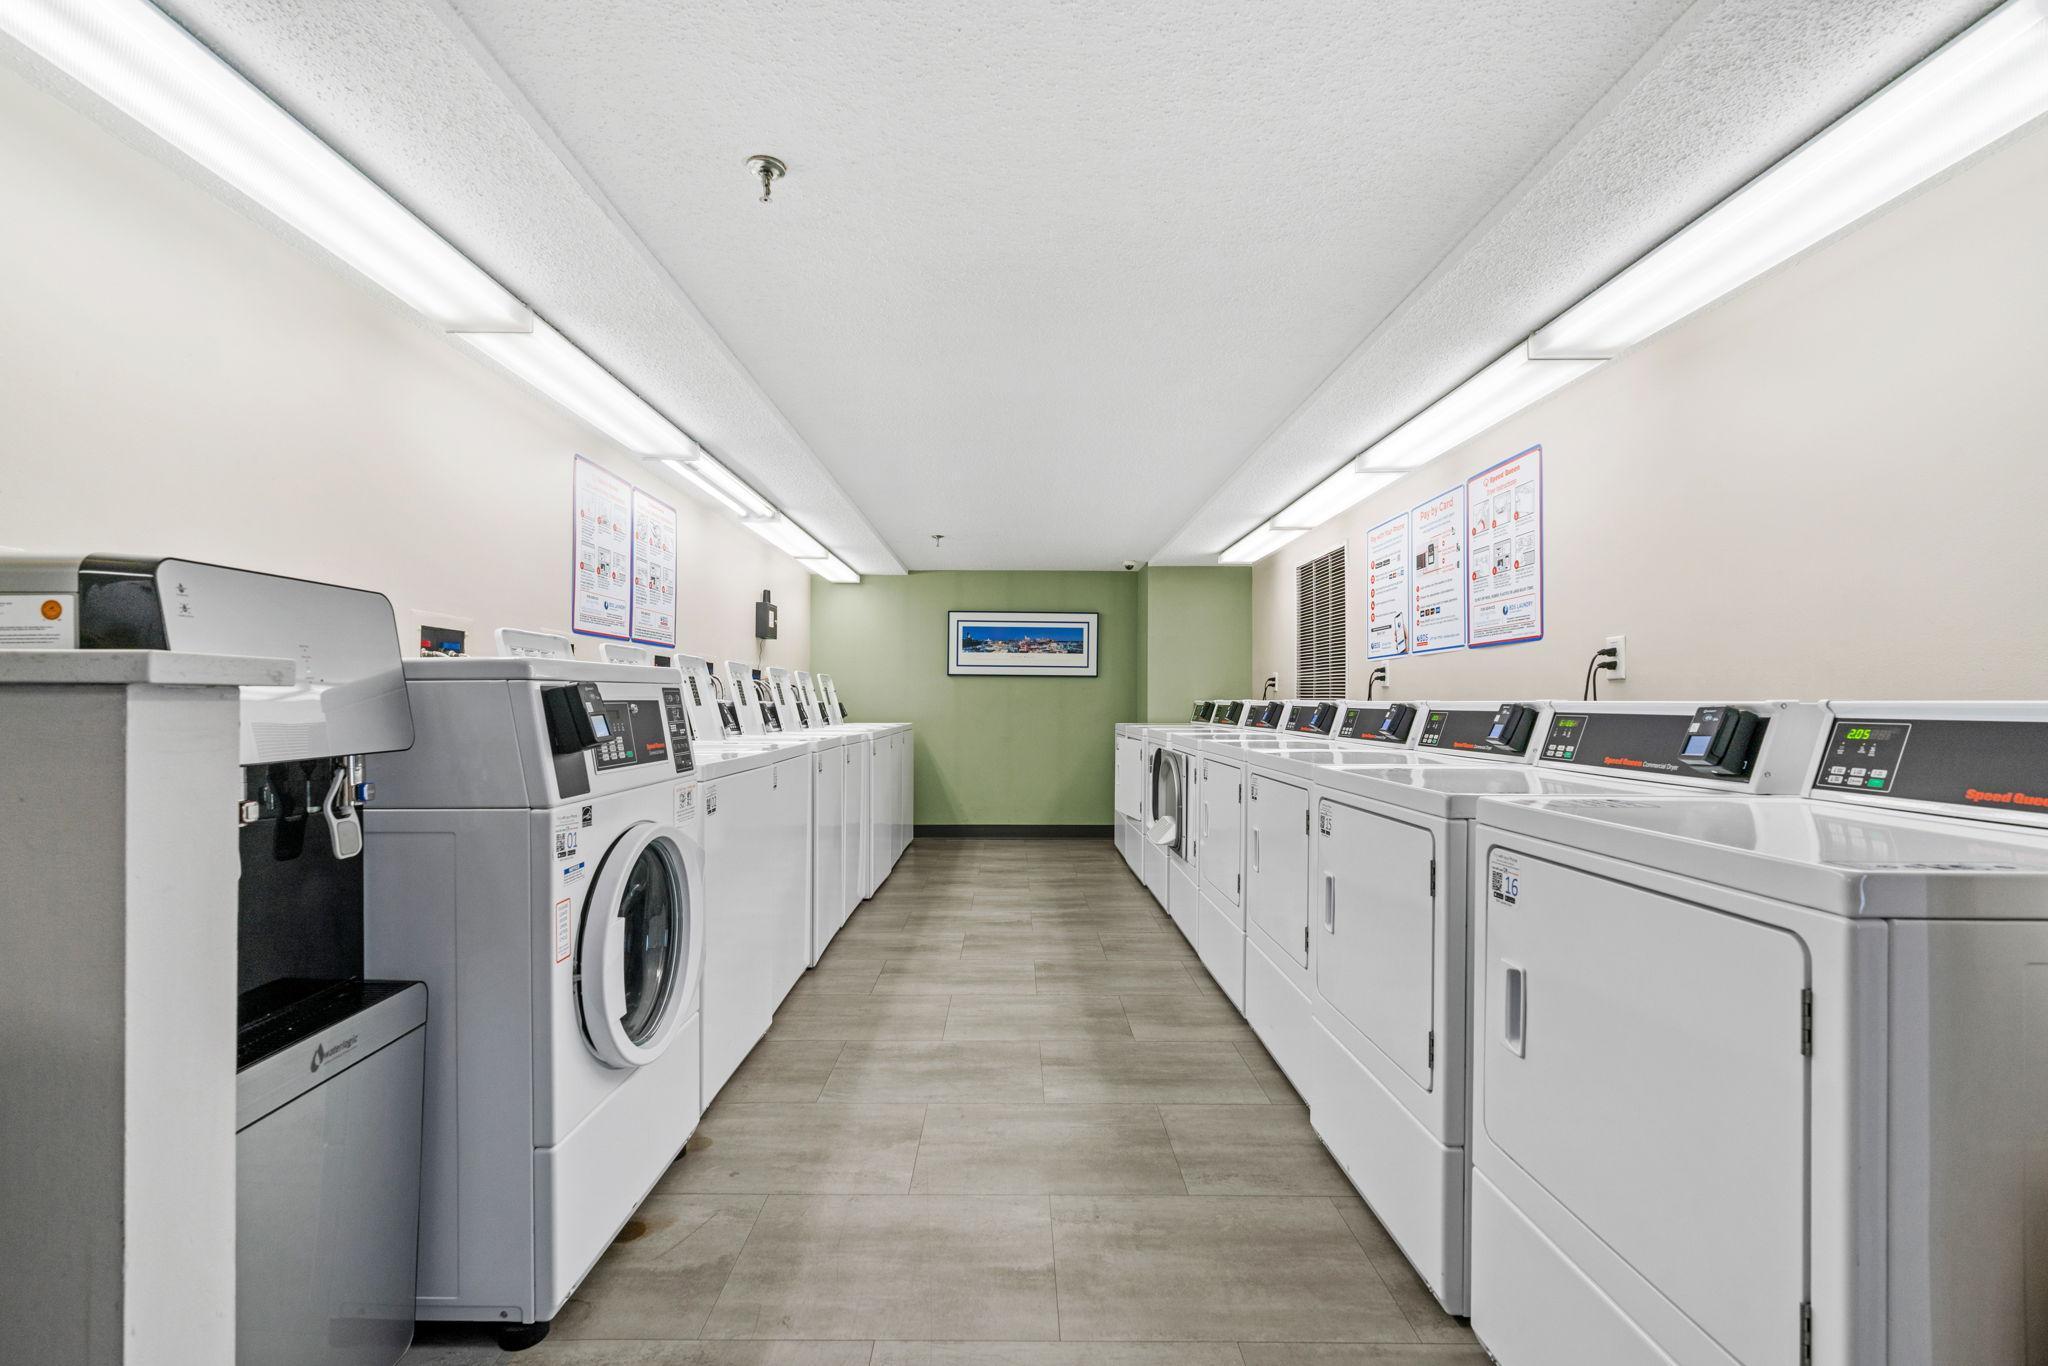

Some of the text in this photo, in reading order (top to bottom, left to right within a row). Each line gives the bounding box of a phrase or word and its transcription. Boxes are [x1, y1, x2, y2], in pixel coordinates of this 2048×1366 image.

[1964, 788, 2013, 803] Speed
[567, 831, 577, 848] 01
[1505, 876, 1519, 897] 16
